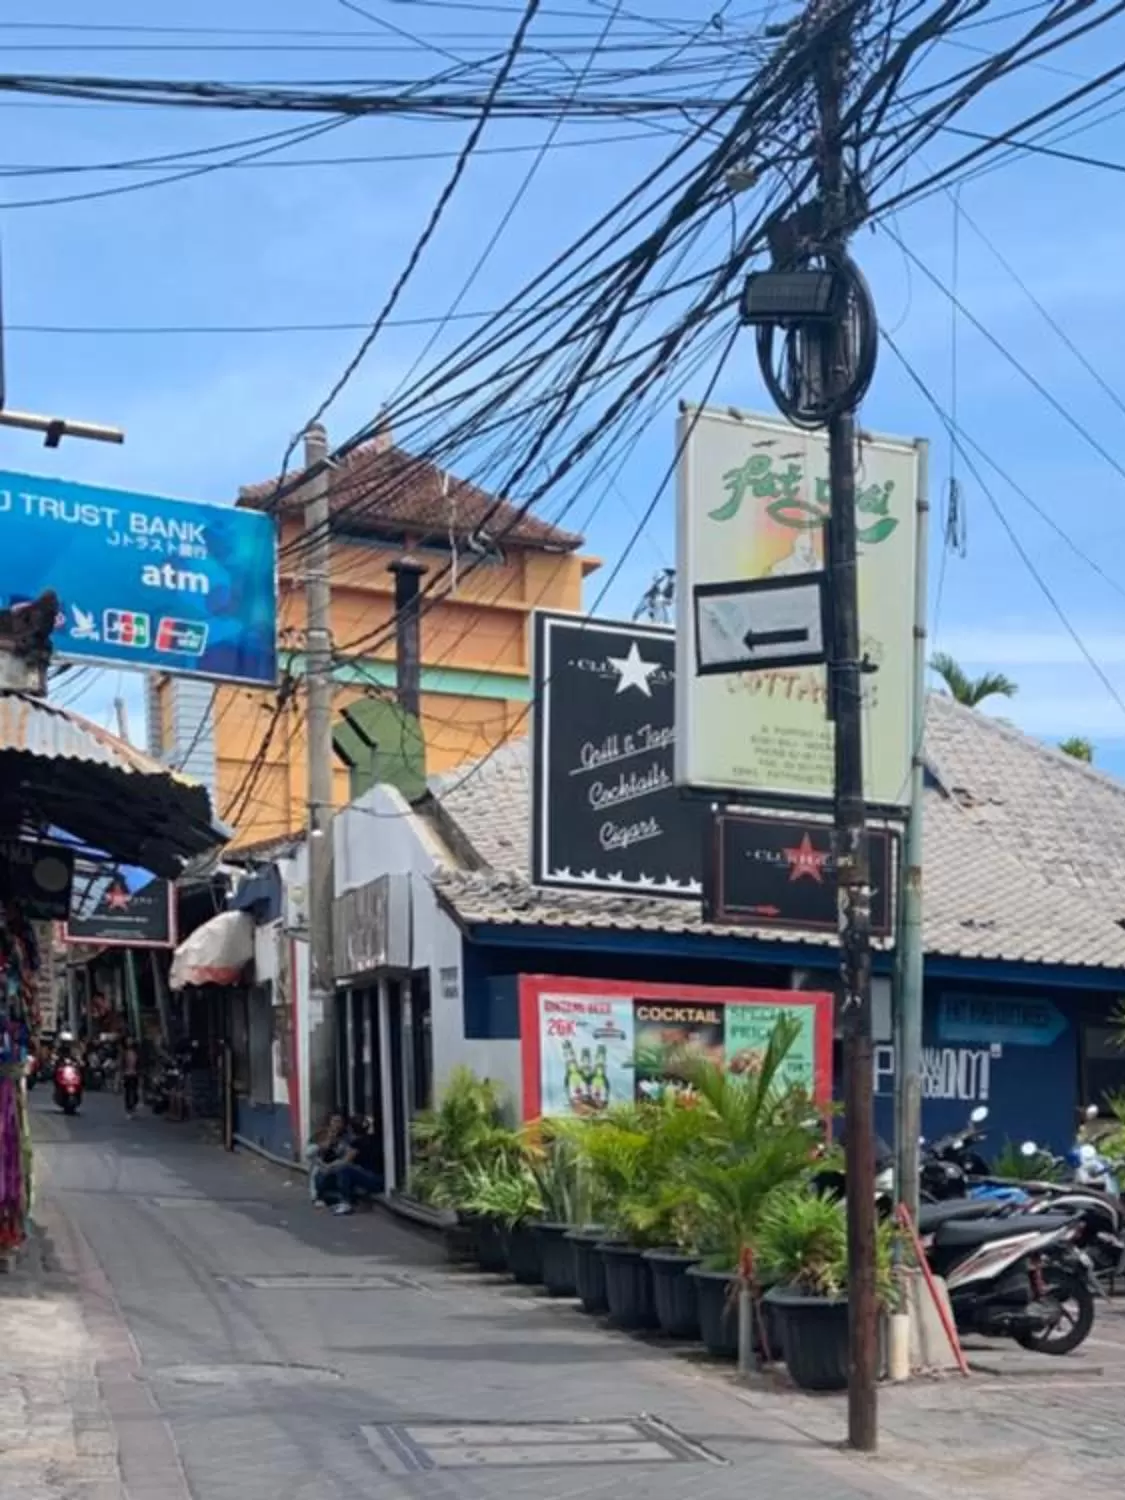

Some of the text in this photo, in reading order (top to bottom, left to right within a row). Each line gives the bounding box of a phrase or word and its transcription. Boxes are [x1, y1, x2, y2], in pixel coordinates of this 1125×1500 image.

[19, 492, 119, 529] TRUST
[130, 511, 206, 545] BANK
[141, 563, 209, 595] atm
[589, 761, 671, 806] Cocktails
[600, 815, 661, 851] Cigars
[637, 1006, 720, 1023] COCKTAIL
